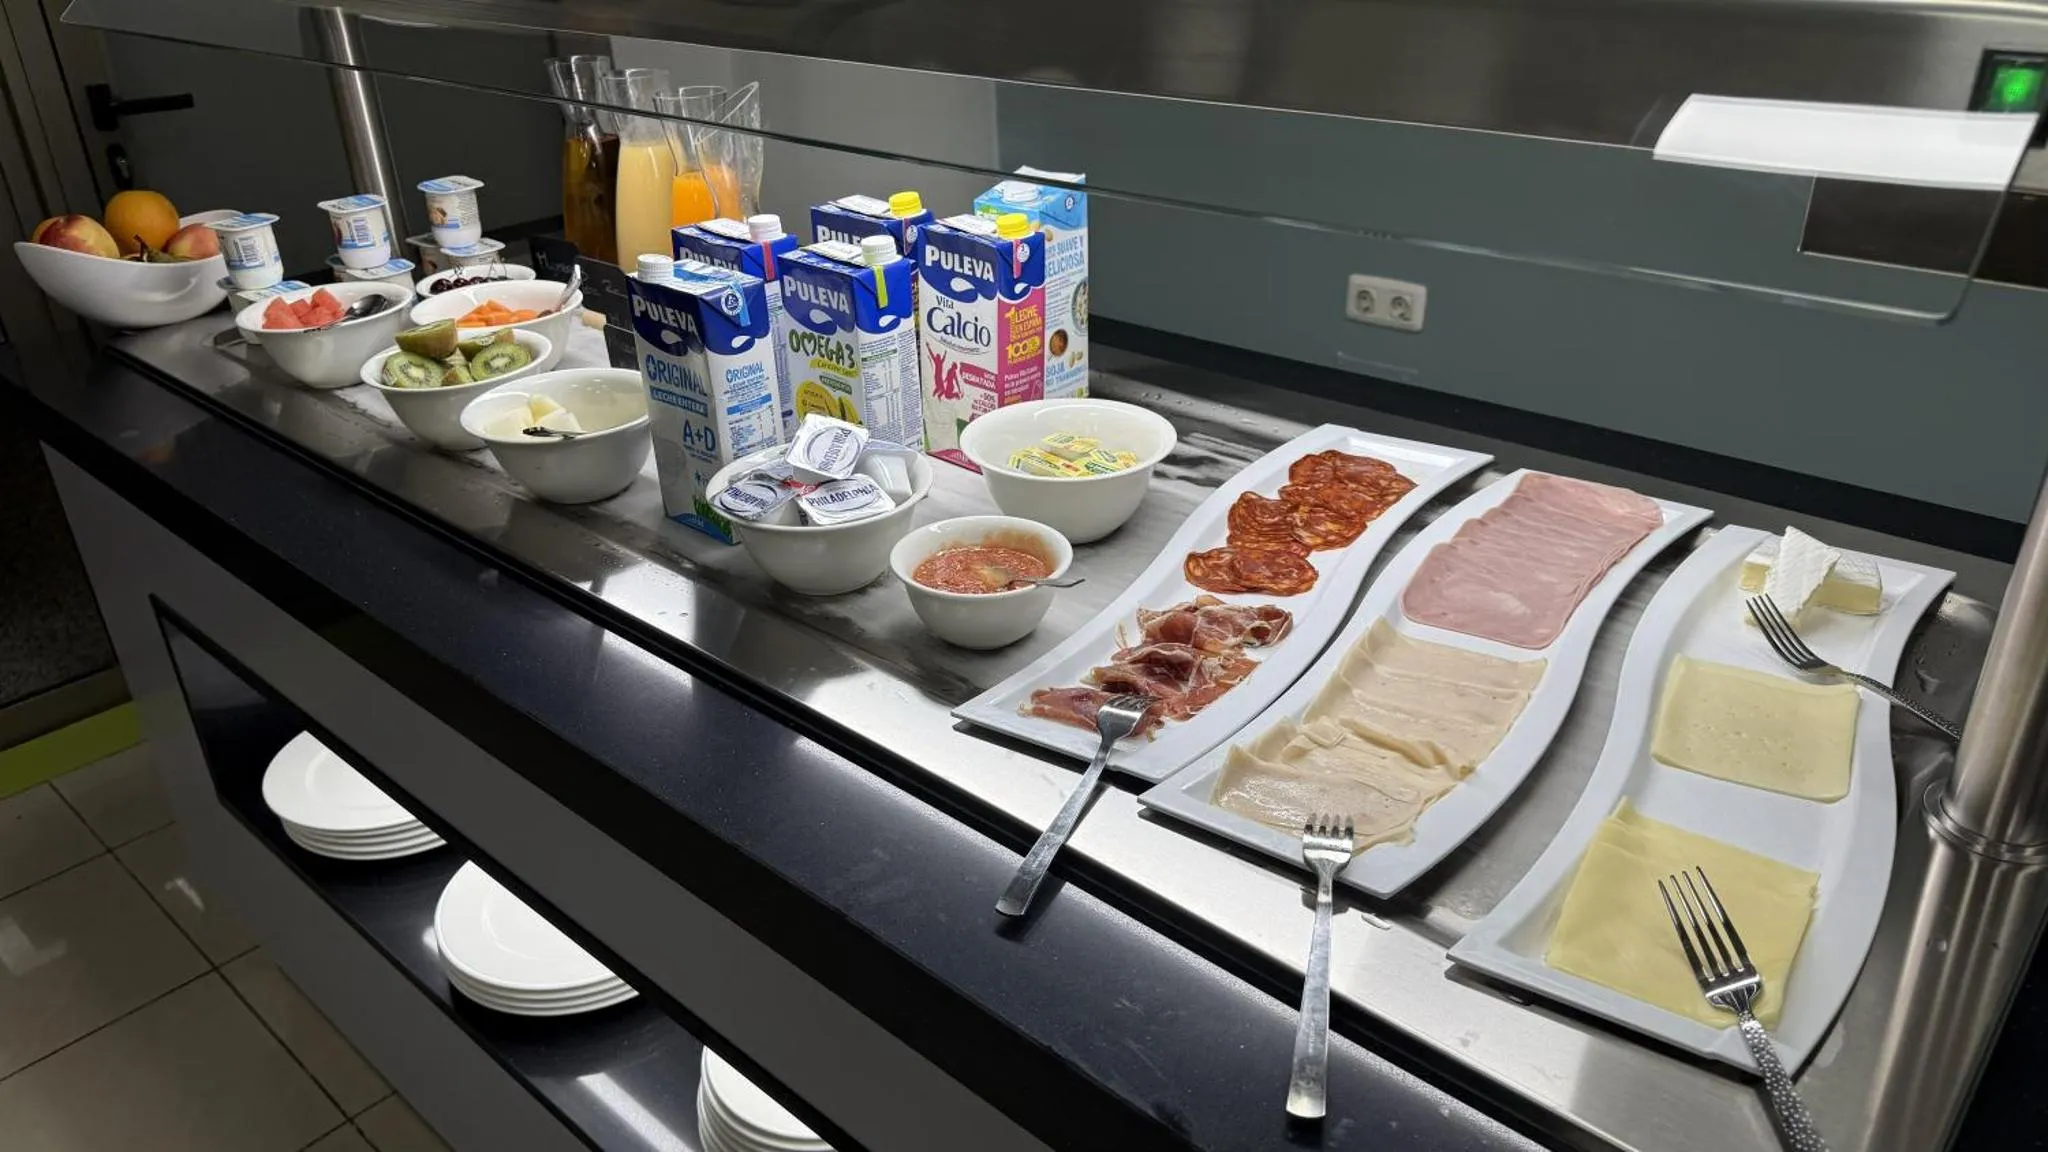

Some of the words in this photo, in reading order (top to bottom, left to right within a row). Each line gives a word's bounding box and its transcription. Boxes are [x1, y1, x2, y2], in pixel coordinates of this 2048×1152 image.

[817, 225, 862, 245] PULE
[925, 244, 995, 283] PULEVA
[783, 275, 850, 314] PULEVA
[631, 294, 698, 334] PULEVA
[926, 306, 991, 347] Calcio
[645, 354, 708, 397] ORIGINAL
[725, 361, 765, 383] ORIGINAL
[653, 389, 677, 404] LECHE
[678, 397, 706, 414] ENTERA
[682, 419, 716, 452] A+D
[807, 483, 880, 508] PHILADELPHIA
